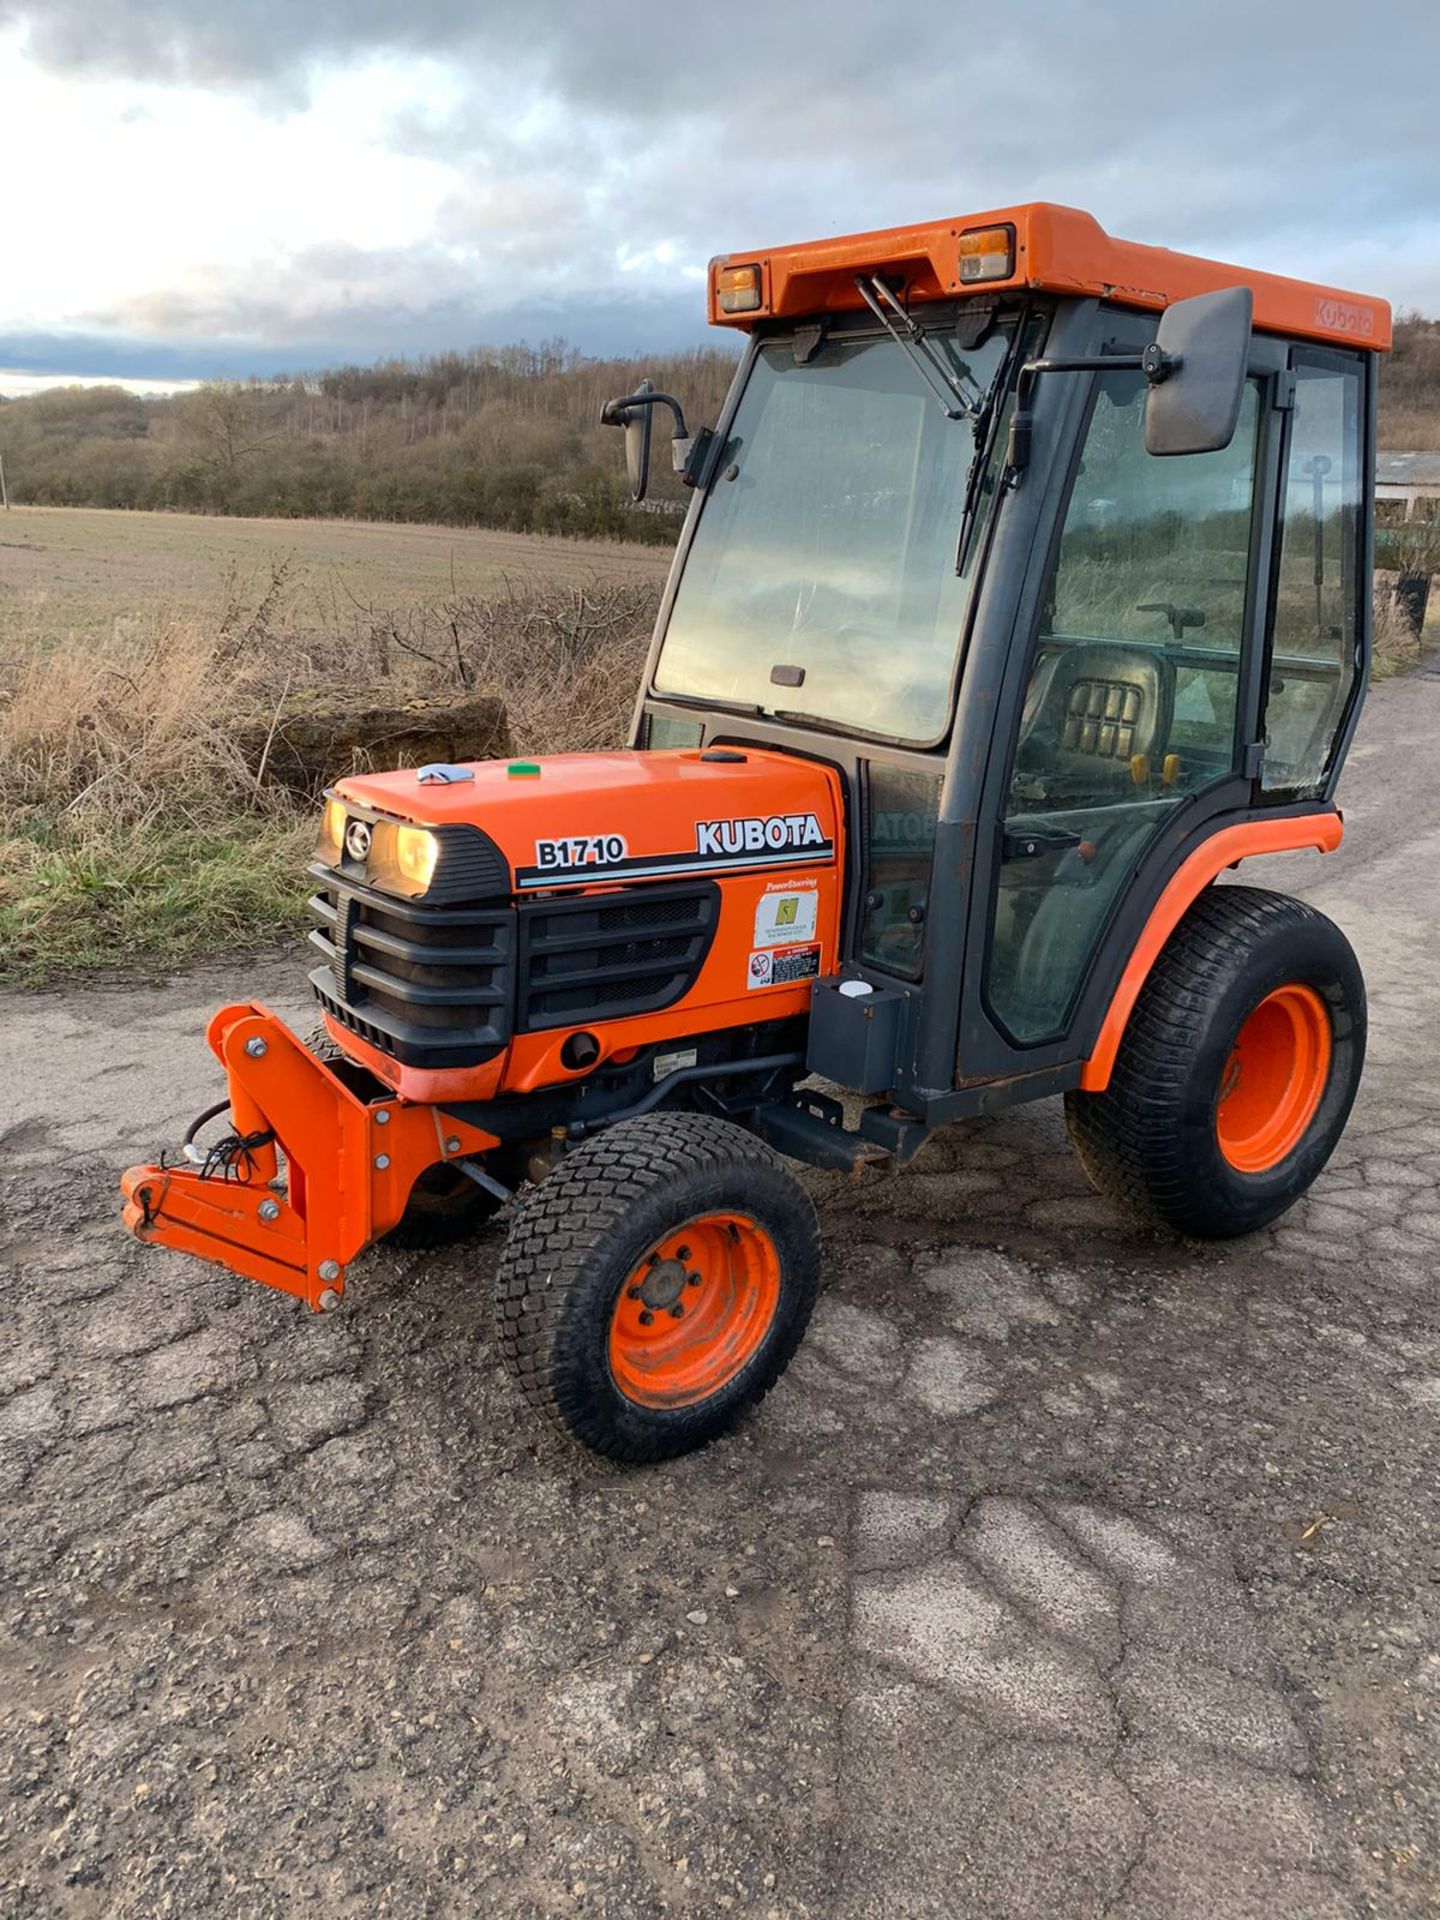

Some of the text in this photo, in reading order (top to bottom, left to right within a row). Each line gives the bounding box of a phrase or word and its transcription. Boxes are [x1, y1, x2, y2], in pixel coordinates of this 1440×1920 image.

[1316, 300, 1372, 333] Kubota
[697, 813, 825, 855] KUBOTA
[538, 835, 625, 868] B1710
